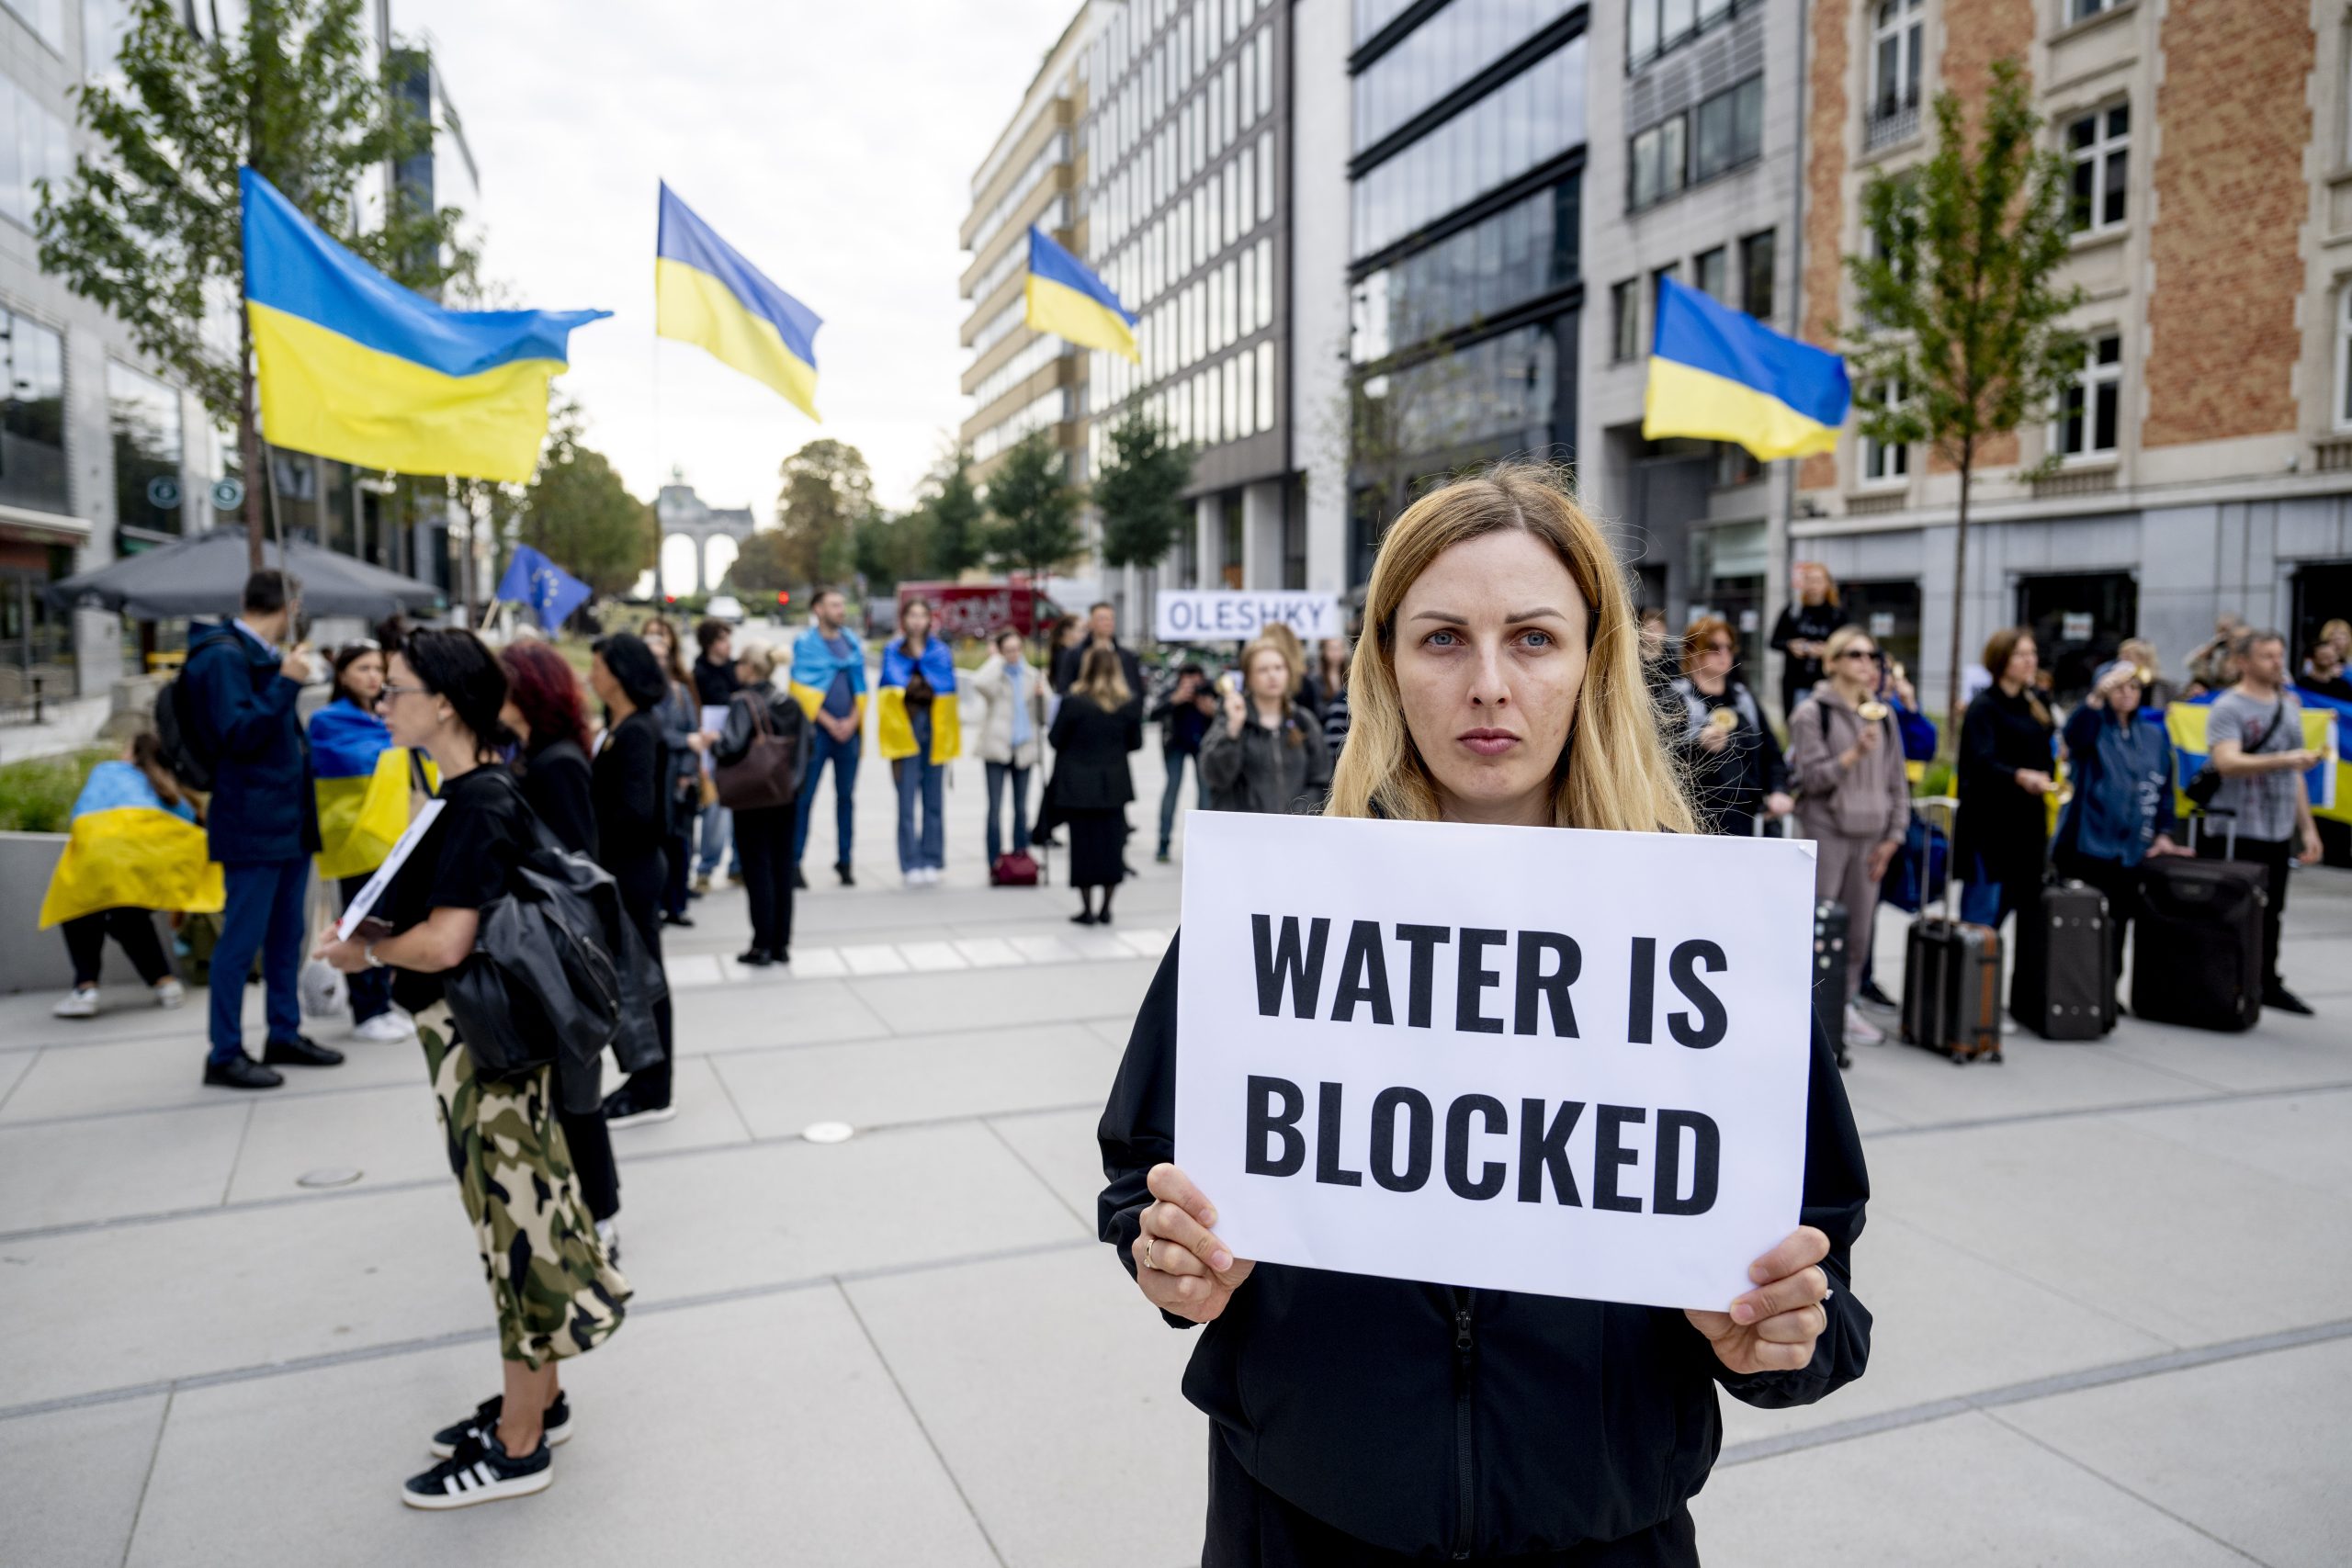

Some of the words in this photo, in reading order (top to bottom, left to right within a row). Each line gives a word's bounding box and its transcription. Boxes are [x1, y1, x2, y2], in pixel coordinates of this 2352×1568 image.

[1169, 600, 1326, 631] OLESHKY
[1251, 913, 1582, 1039] WATER
[1627, 936, 1728, 1049] IS
[1245, 1074, 1721, 1216] BLOCKED
